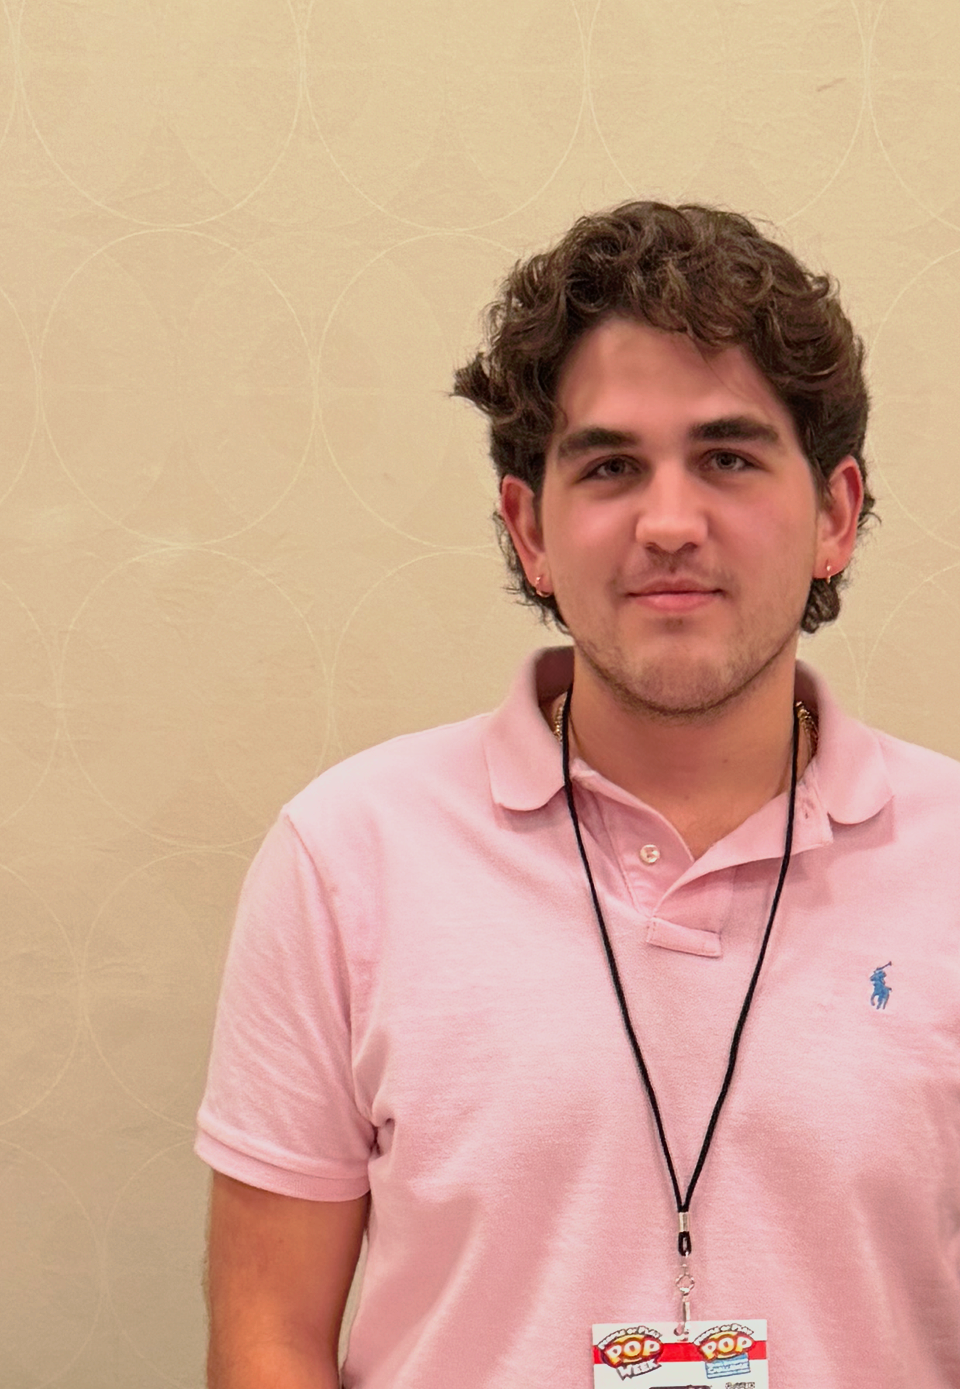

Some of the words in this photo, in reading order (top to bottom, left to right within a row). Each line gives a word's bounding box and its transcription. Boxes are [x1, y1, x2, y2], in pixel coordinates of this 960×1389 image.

[606, 1339, 661, 1366] POP
[701, 1336, 752, 1362] POP
[618, 1360, 660, 1379] WEEK
